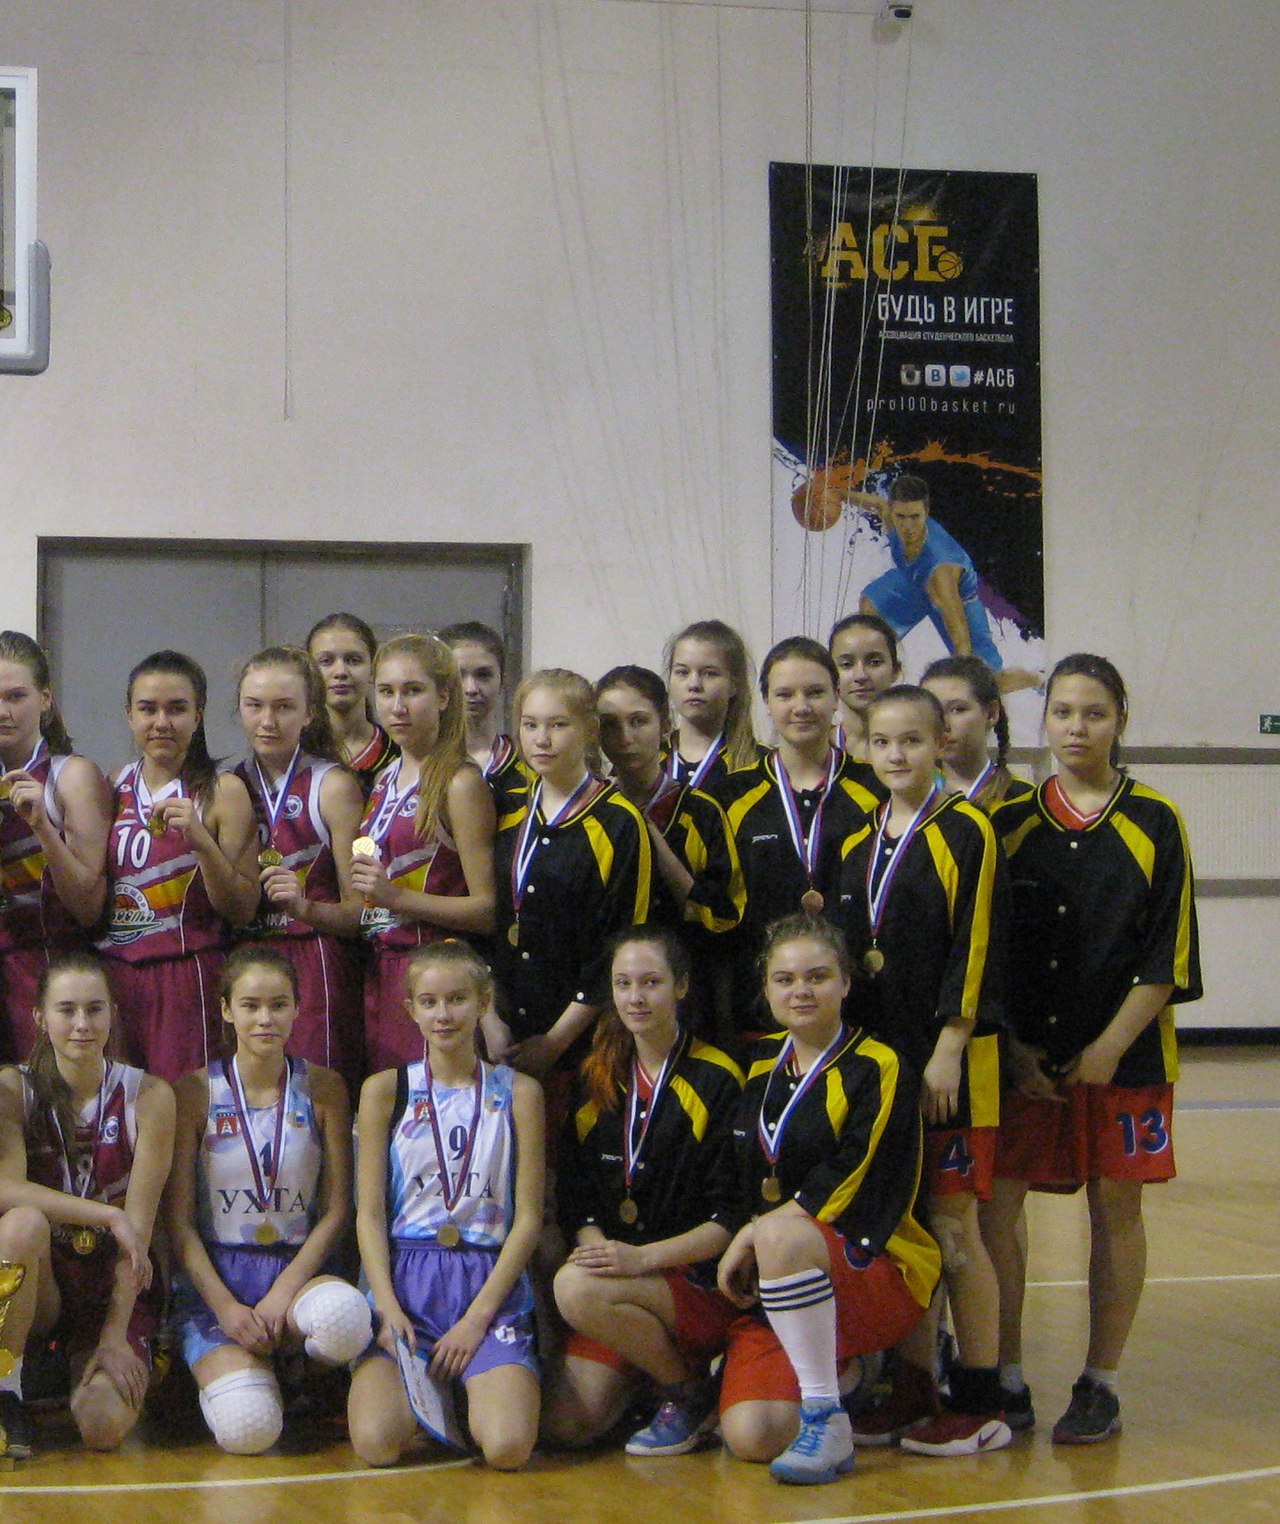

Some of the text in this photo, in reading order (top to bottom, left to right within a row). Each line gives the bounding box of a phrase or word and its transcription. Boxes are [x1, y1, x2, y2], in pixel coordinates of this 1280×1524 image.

[821, 222, 963, 282] АСБ
[877, 293, 1014, 325] БУДЬ В ИГРЕ
[973, 368, 1015, 388] #АСБ
[866, 396, 1016, 414] pro100basketru
[117, 826, 151, 869] 10
[449, 1125, 468, 1161] 9
[1116, 1107, 1169, 1156] 13
[940, 1133, 975, 1177] 4
[217, 1188, 306, 1213] УХТА
